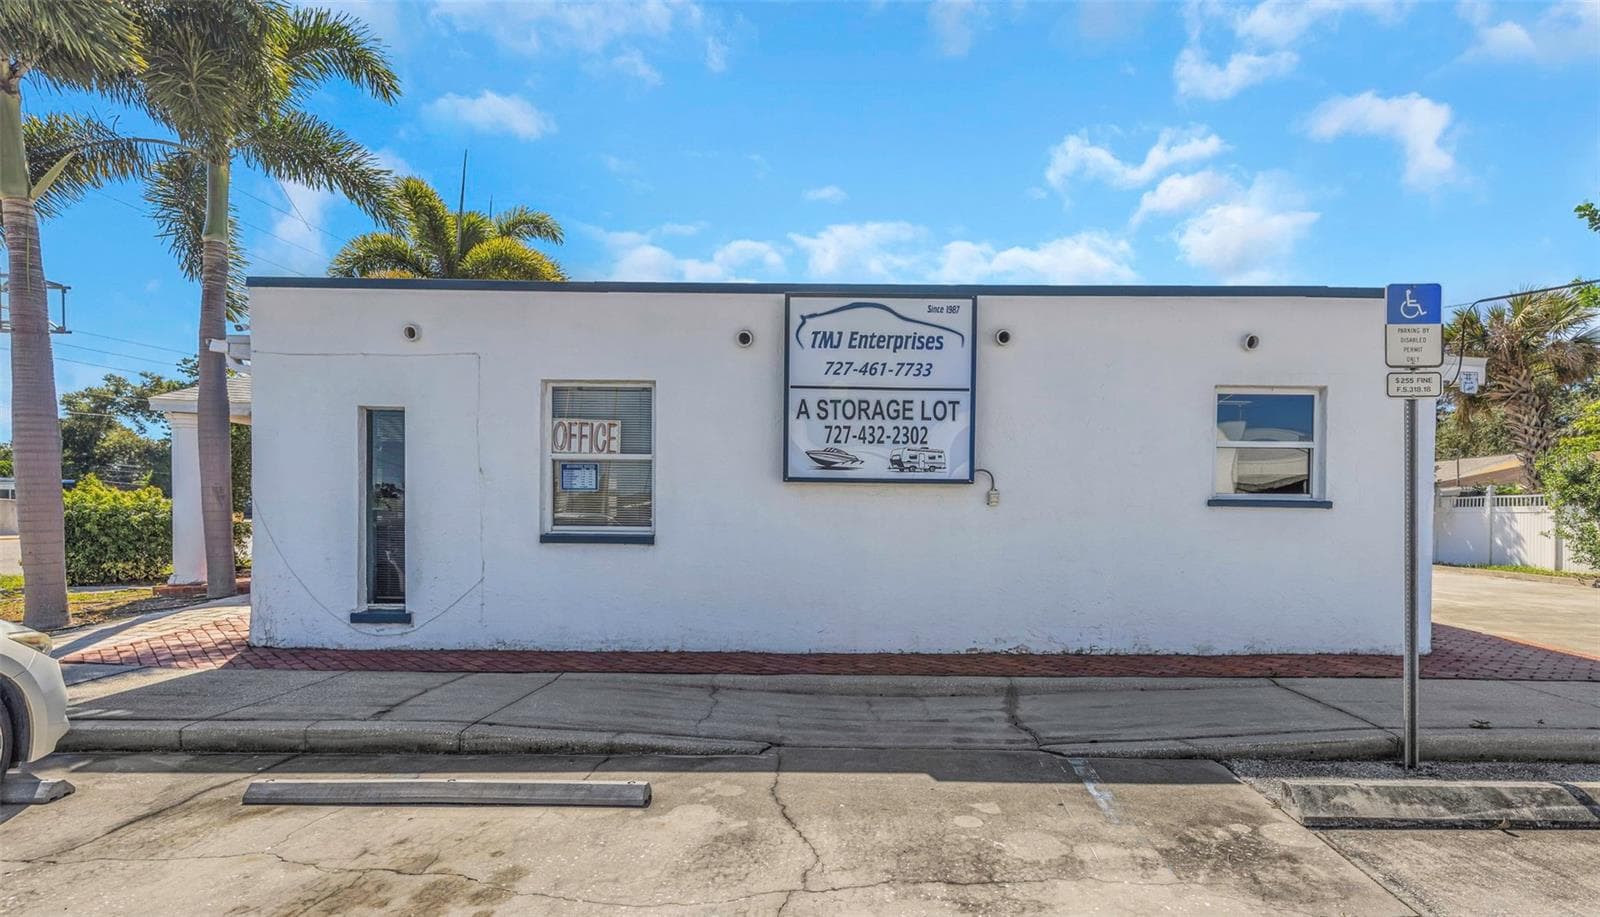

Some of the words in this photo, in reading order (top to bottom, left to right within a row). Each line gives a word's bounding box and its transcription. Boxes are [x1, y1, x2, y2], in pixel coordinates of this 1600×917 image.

[927, 304, 944, 314] Since
[945, 305, 960, 314] 1987
[810, 330, 843, 349] TMJ
[848, 331, 944, 353] Enterprises
[823, 361, 933, 377] 727-461-7733
[796, 398, 810, 420] A
[816, 399, 914, 421] STORAGE
[920, 400, 960, 421] LOT
[553, 420, 618, 454] OFFICE
[824, 425, 928, 445] 727-432-2302
